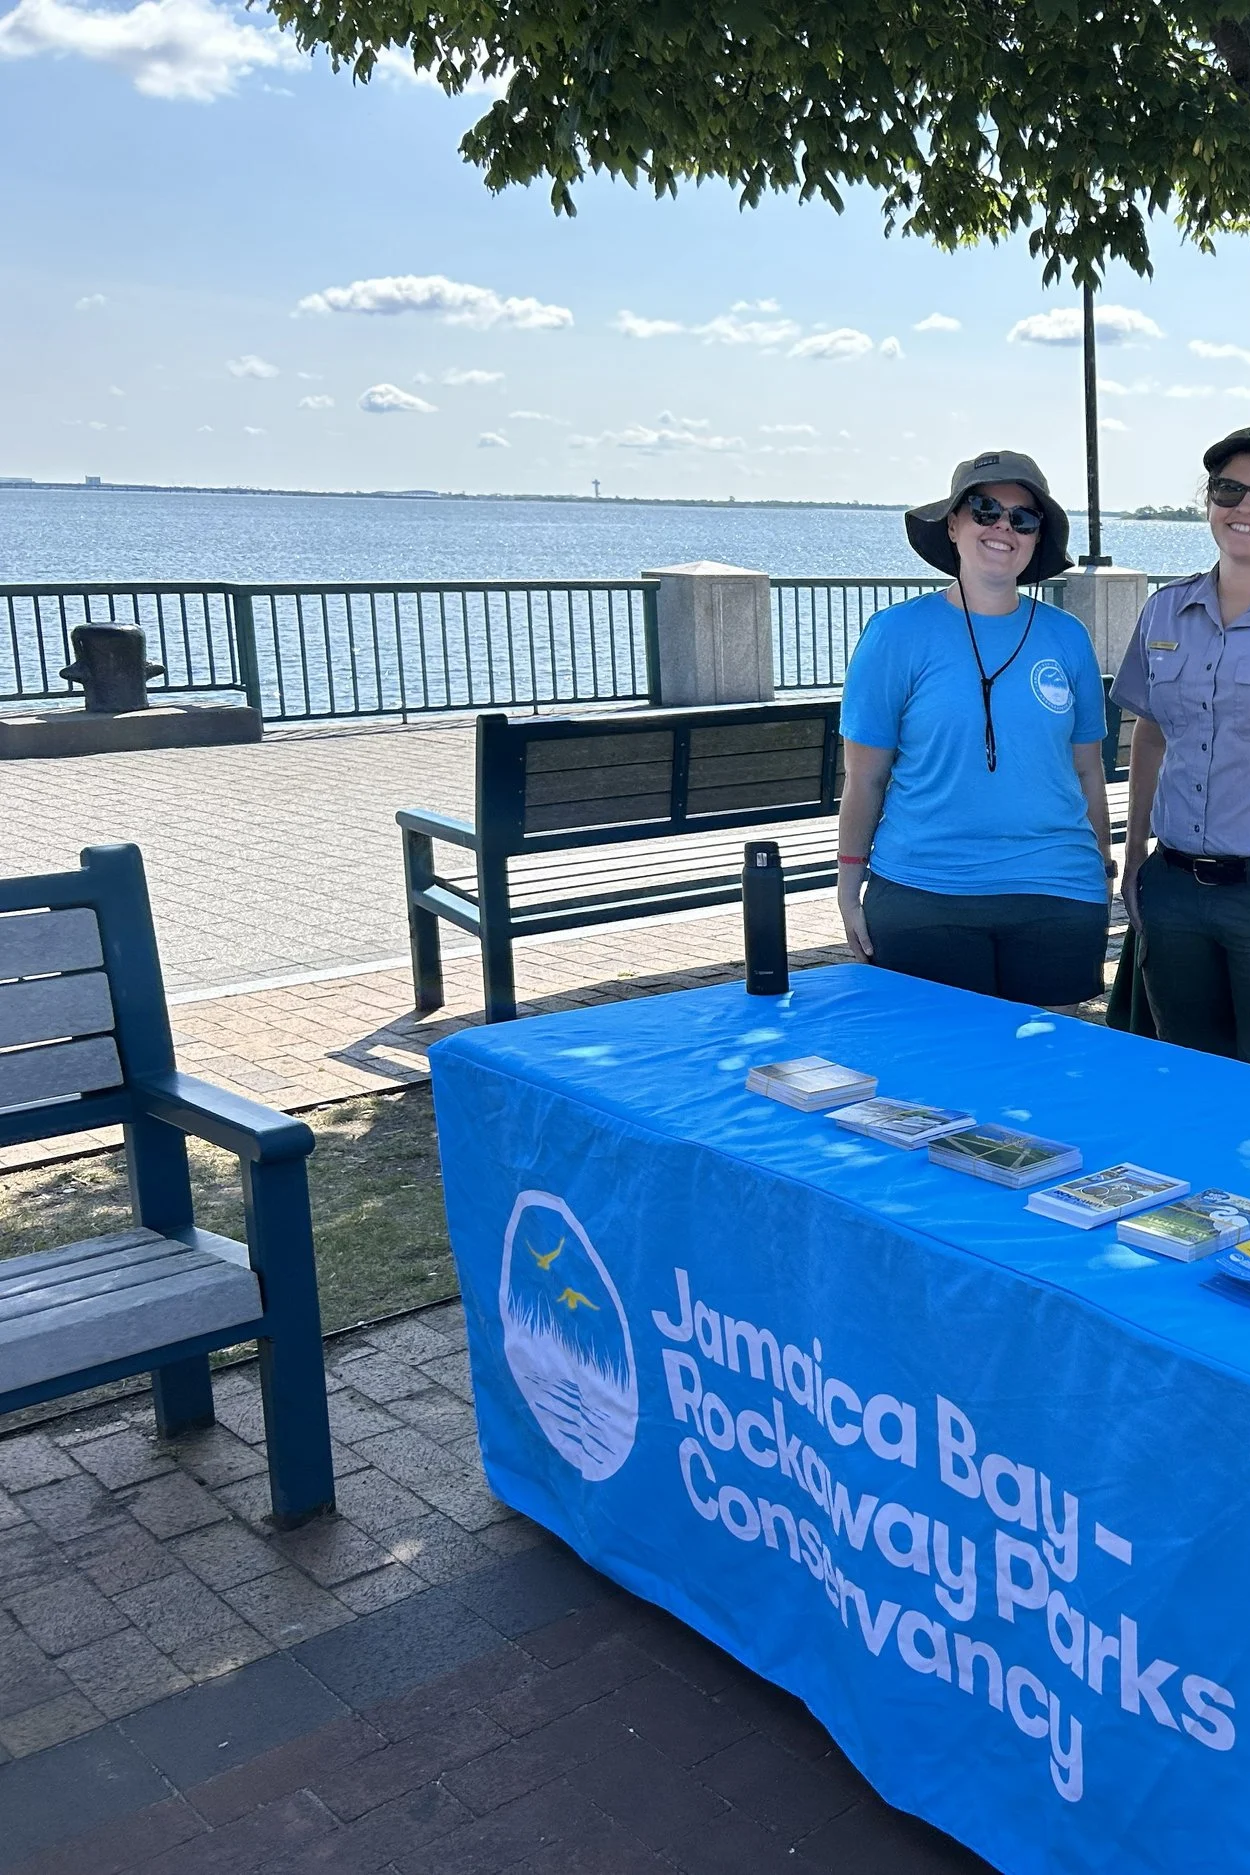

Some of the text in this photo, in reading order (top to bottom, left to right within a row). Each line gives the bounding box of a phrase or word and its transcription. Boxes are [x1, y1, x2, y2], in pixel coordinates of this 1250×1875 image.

[651, 1267, 917, 1468] Jamaica
[662, 1348, 1236, 1751] Rockaway Parks
[679, 1437, 1084, 1802] Conservancy
